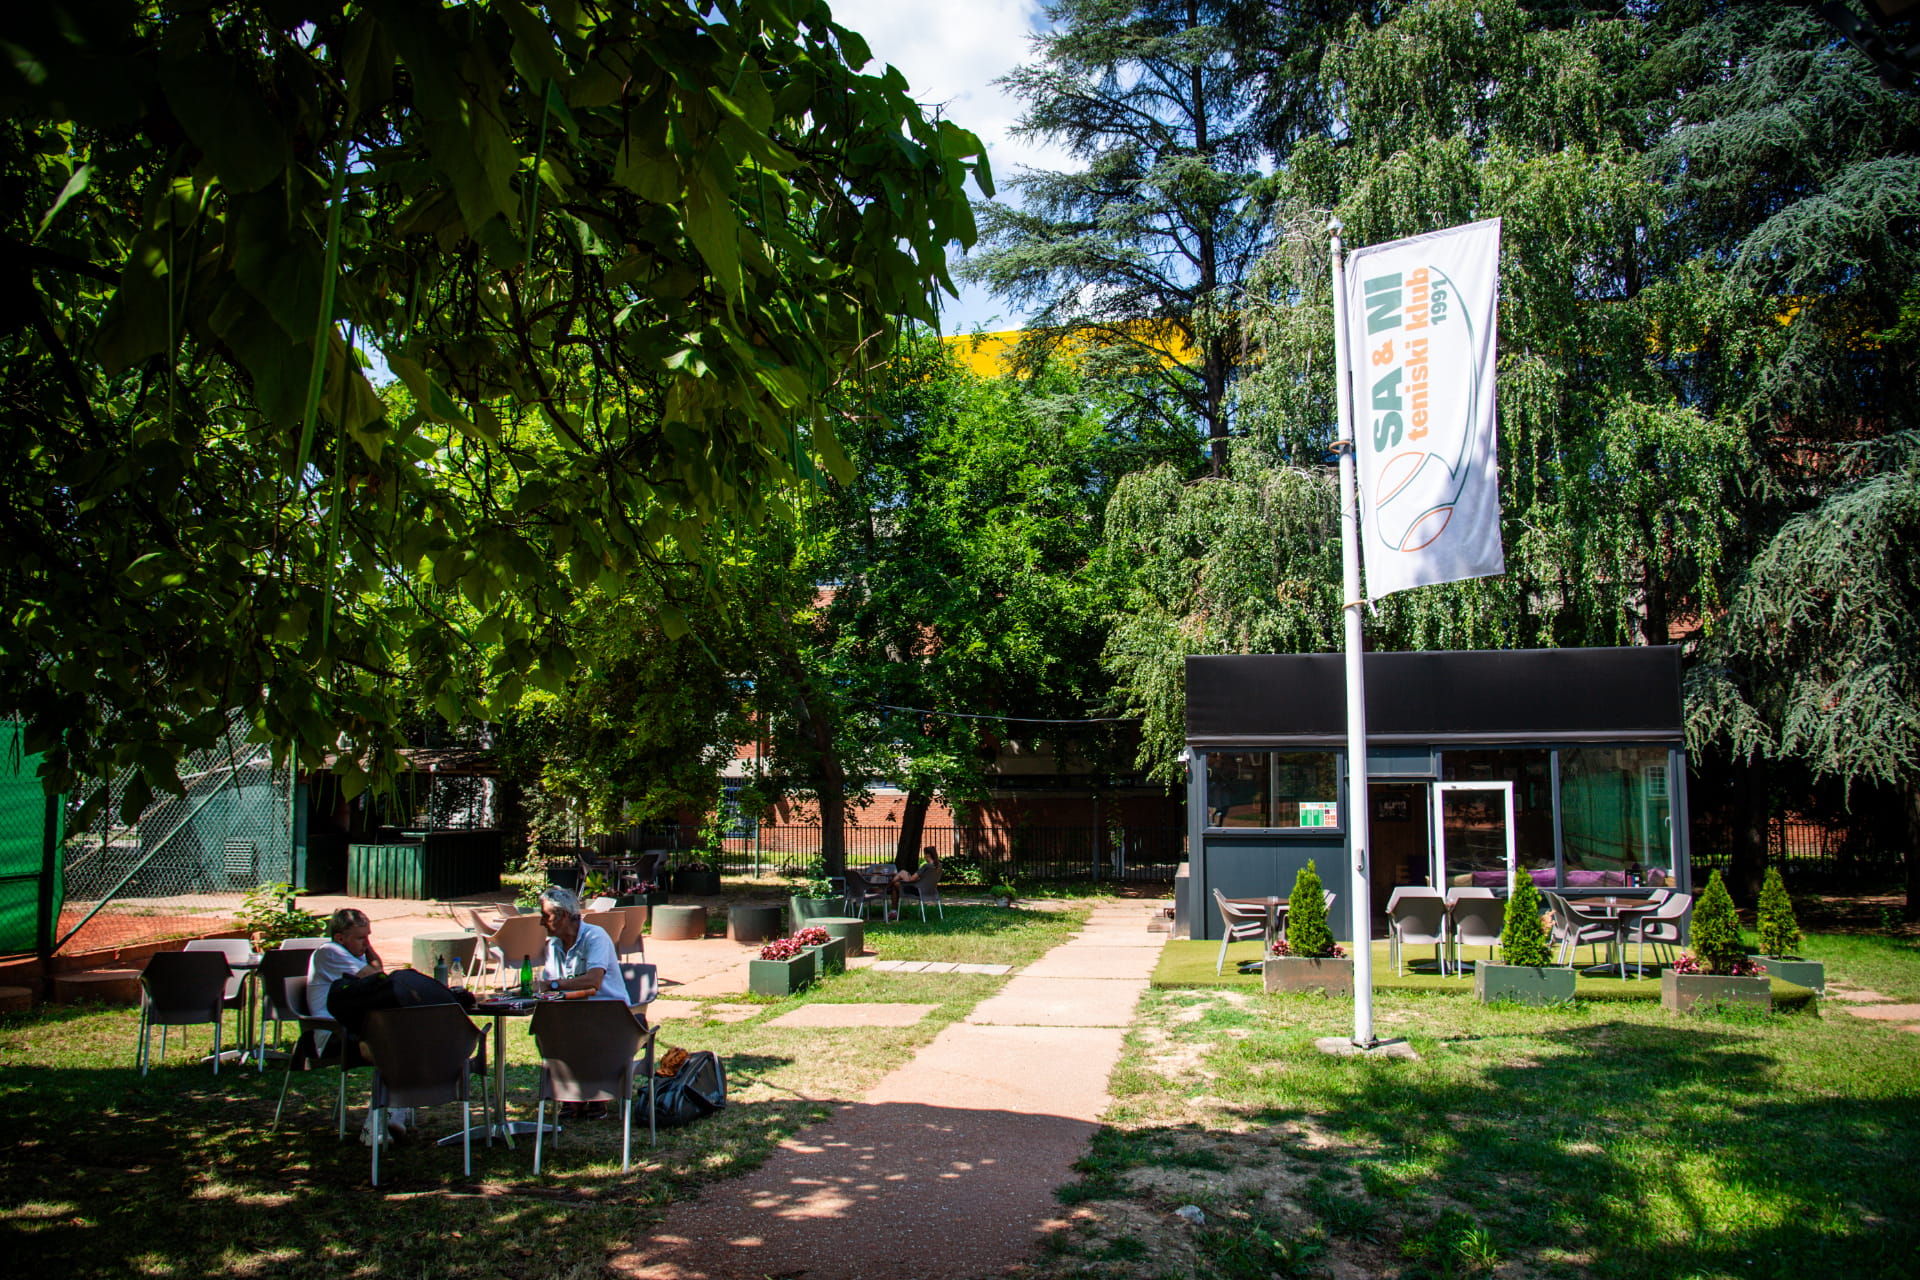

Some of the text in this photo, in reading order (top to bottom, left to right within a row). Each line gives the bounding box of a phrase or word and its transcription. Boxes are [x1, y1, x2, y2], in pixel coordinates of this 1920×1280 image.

[1364, 272, 1402, 452] SA & NI
[1405, 267, 1429, 441] teniski klub
[1430, 278, 1448, 326] 1991
